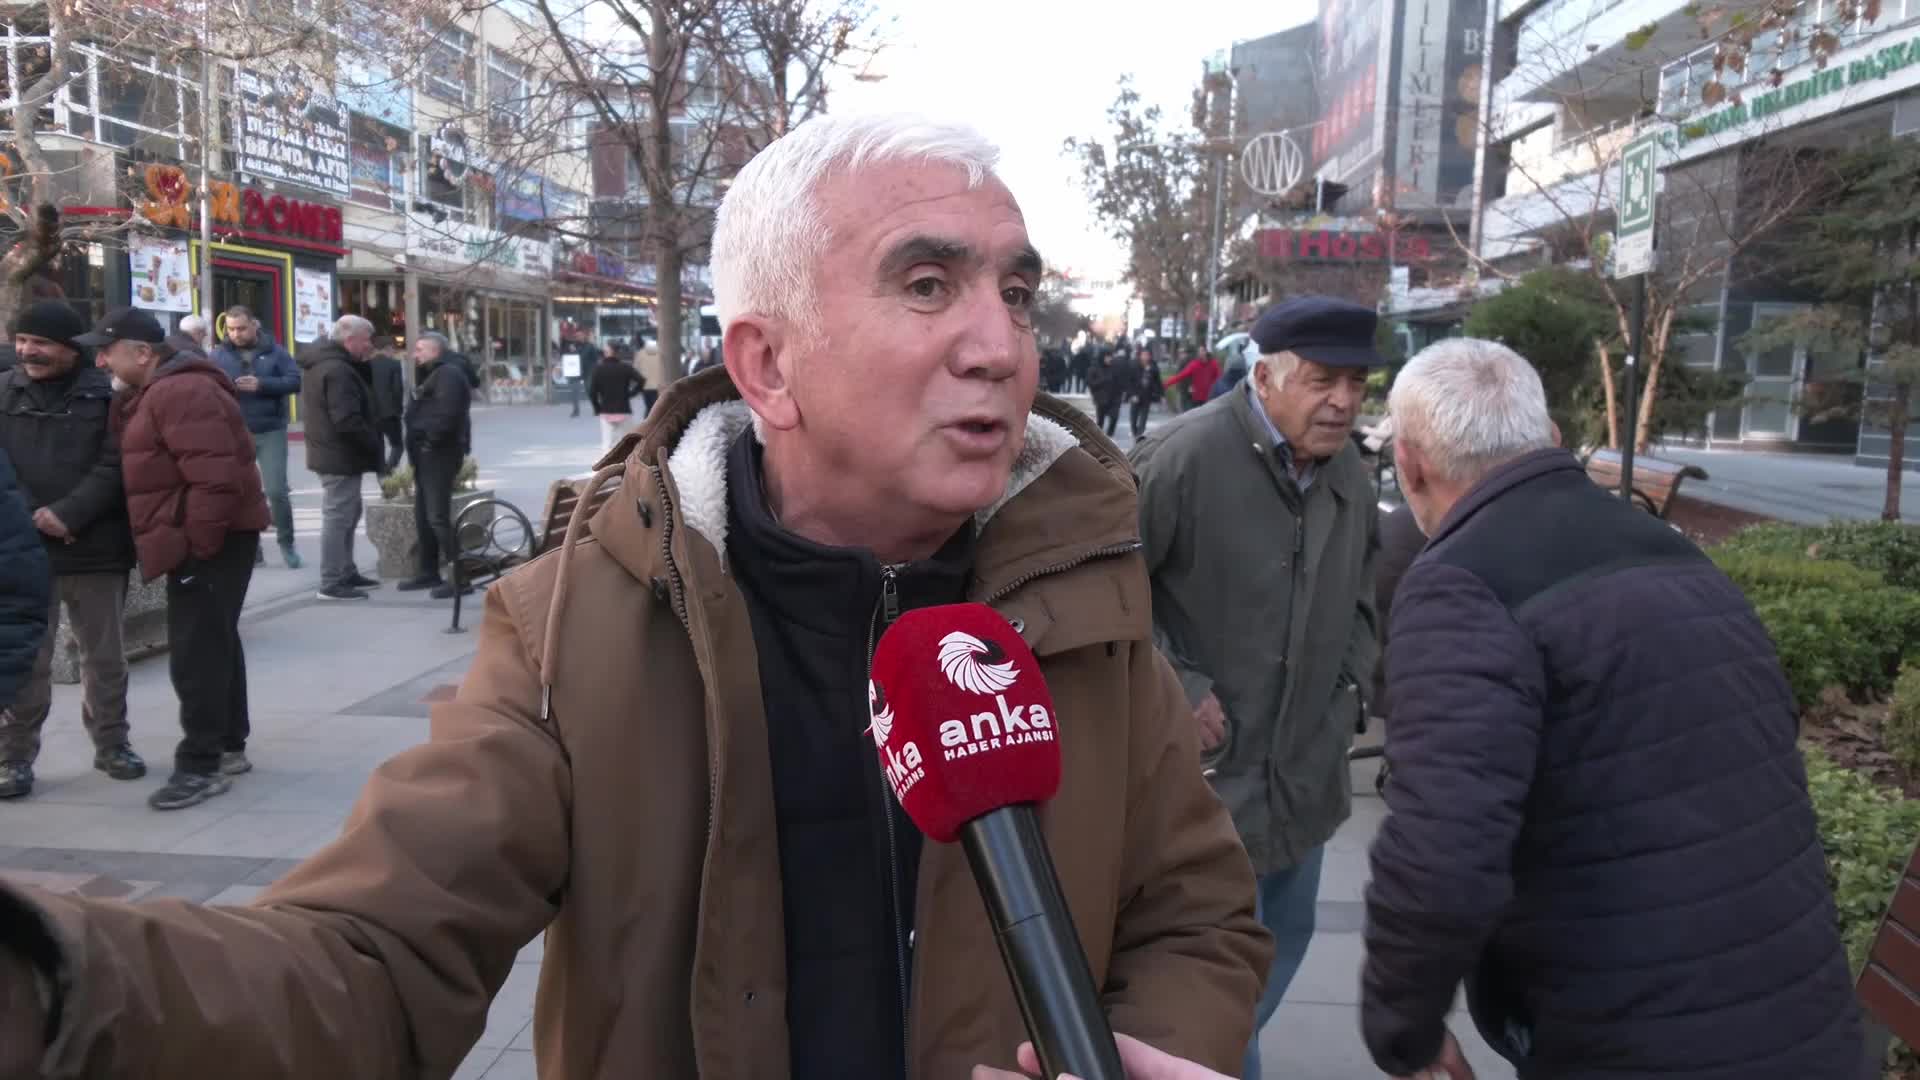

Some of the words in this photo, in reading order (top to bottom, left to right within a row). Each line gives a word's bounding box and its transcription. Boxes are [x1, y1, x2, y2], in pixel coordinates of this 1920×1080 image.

[940, 694, 1051, 747] anka
[944, 738, 1001, 761] HABER
[1006, 730, 1054, 746] AJANSI
